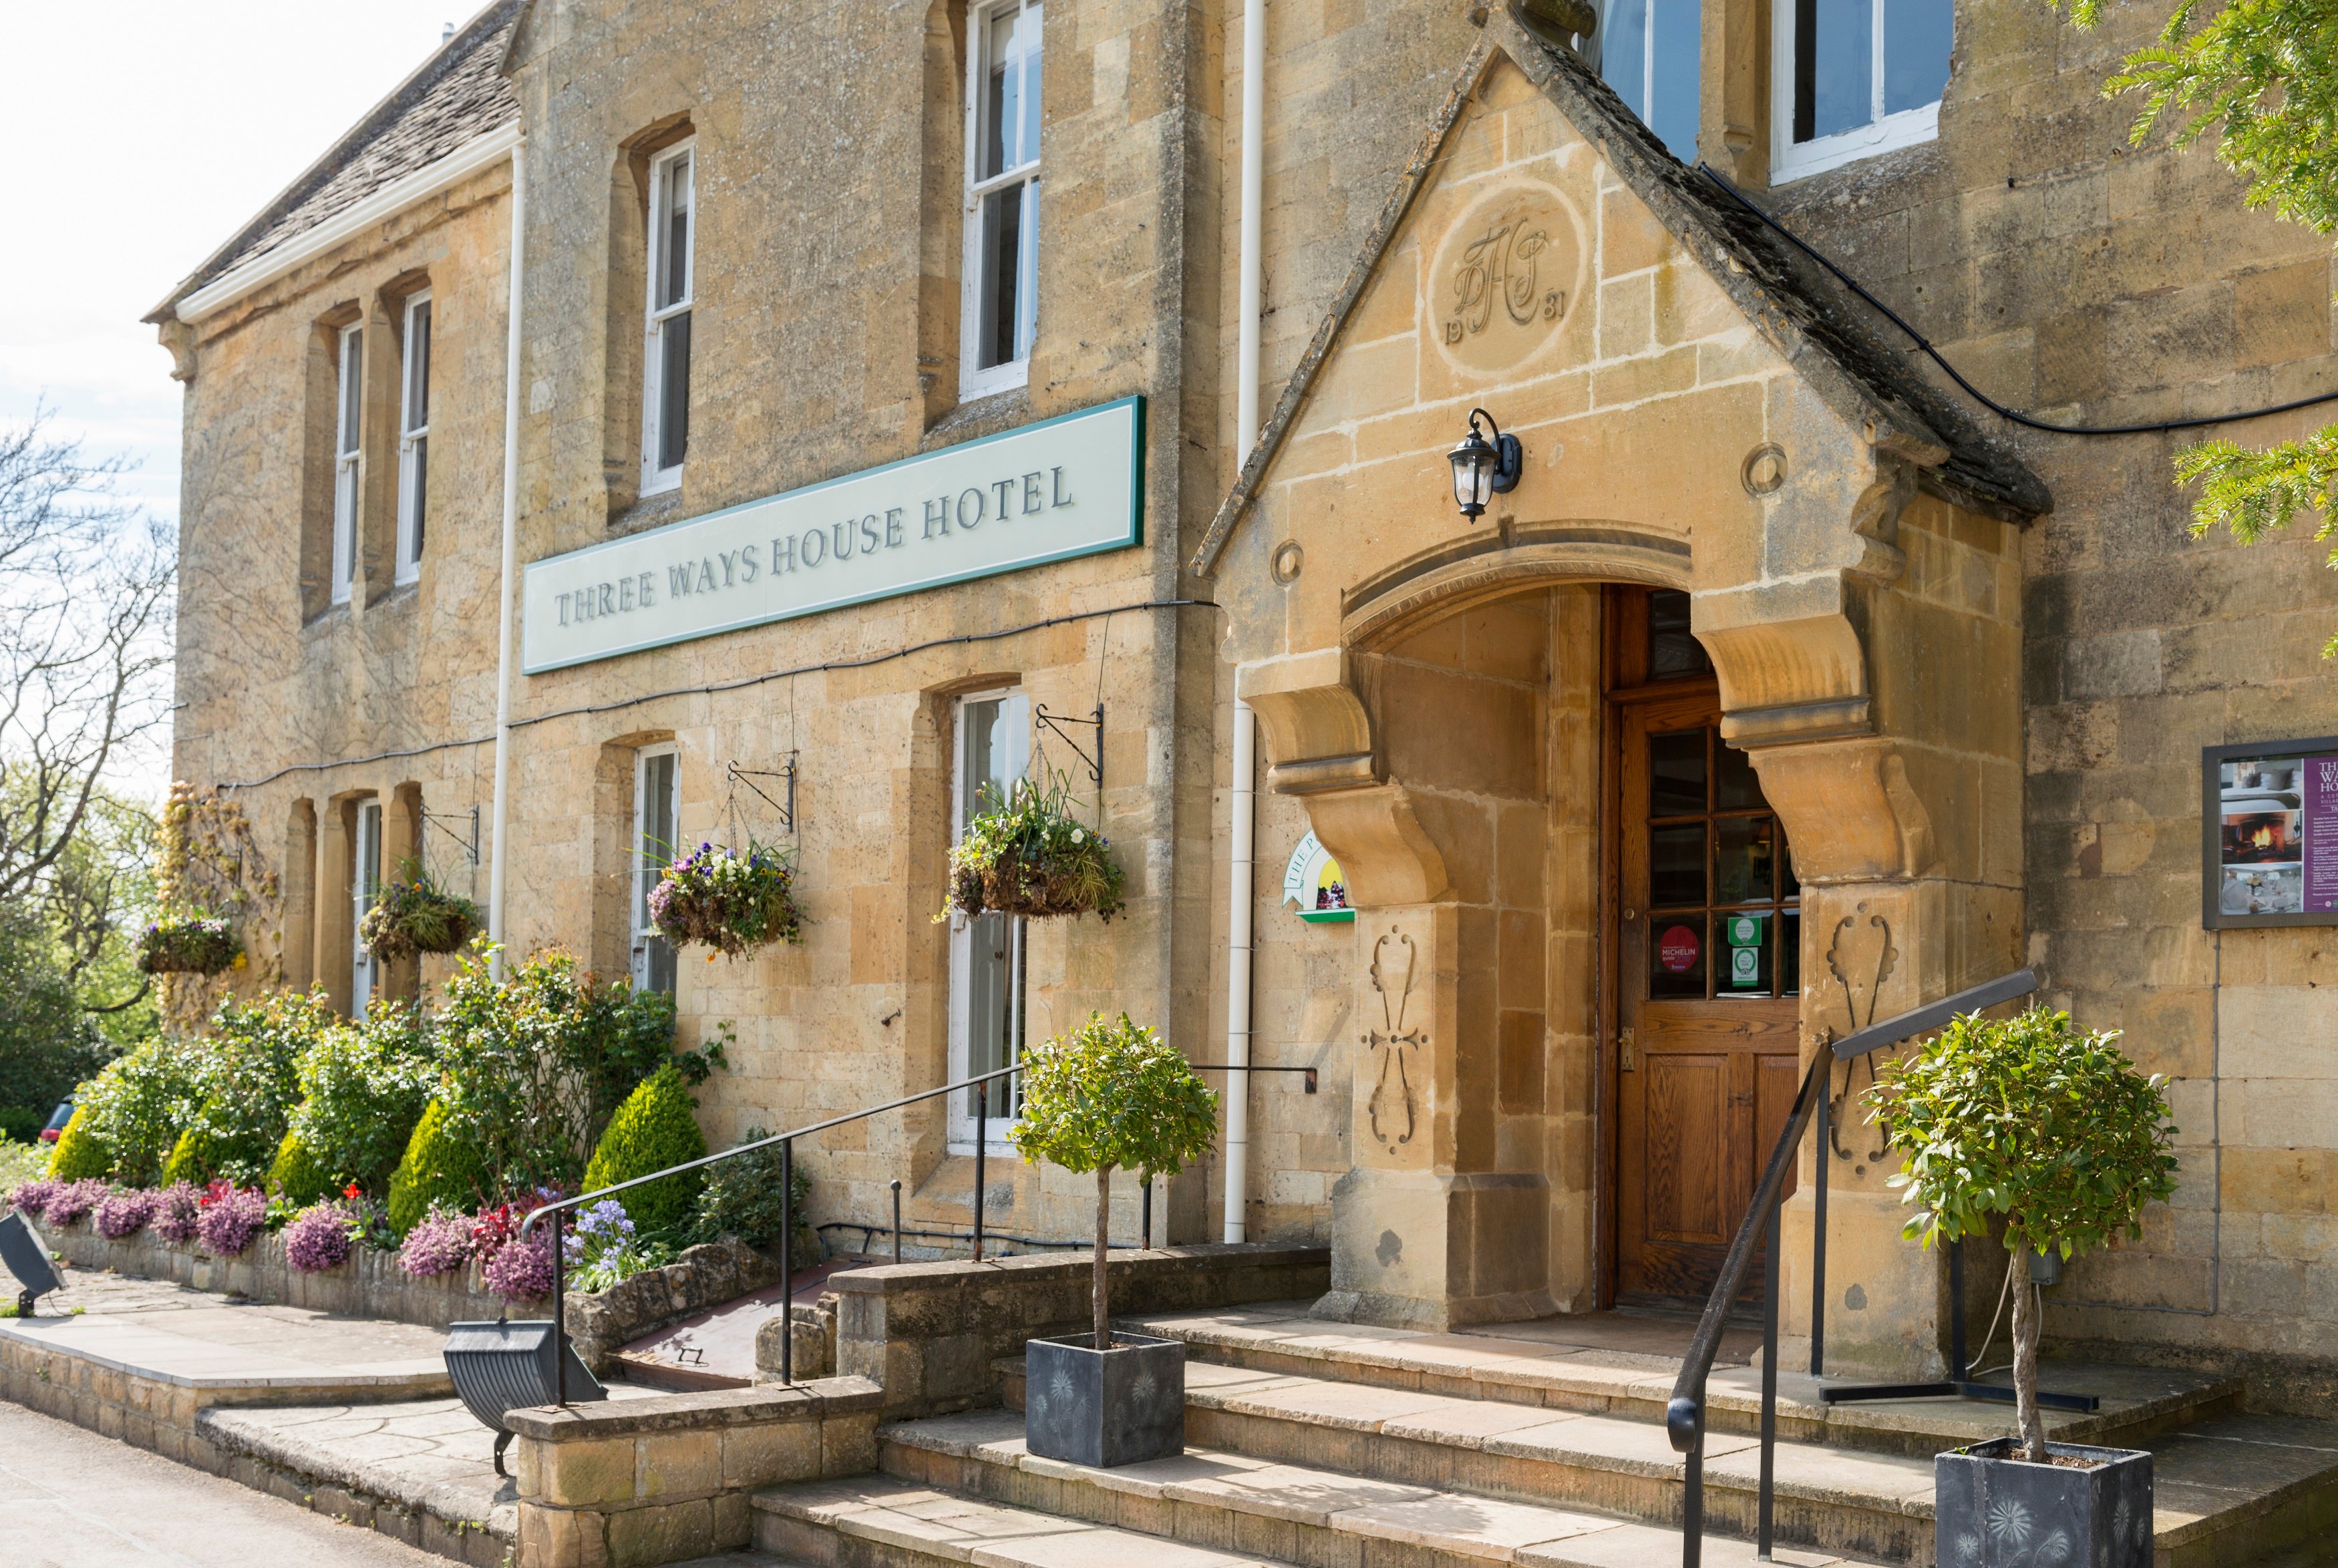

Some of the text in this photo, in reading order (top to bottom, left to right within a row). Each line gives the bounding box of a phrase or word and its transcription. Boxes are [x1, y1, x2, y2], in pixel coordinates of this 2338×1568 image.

[554, 465, 1073, 626] THREE WAYS HOUSE HOTEL
[1288, 849, 1307, 884] THE
[1662, 948, 1695, 956] MICHELIN
